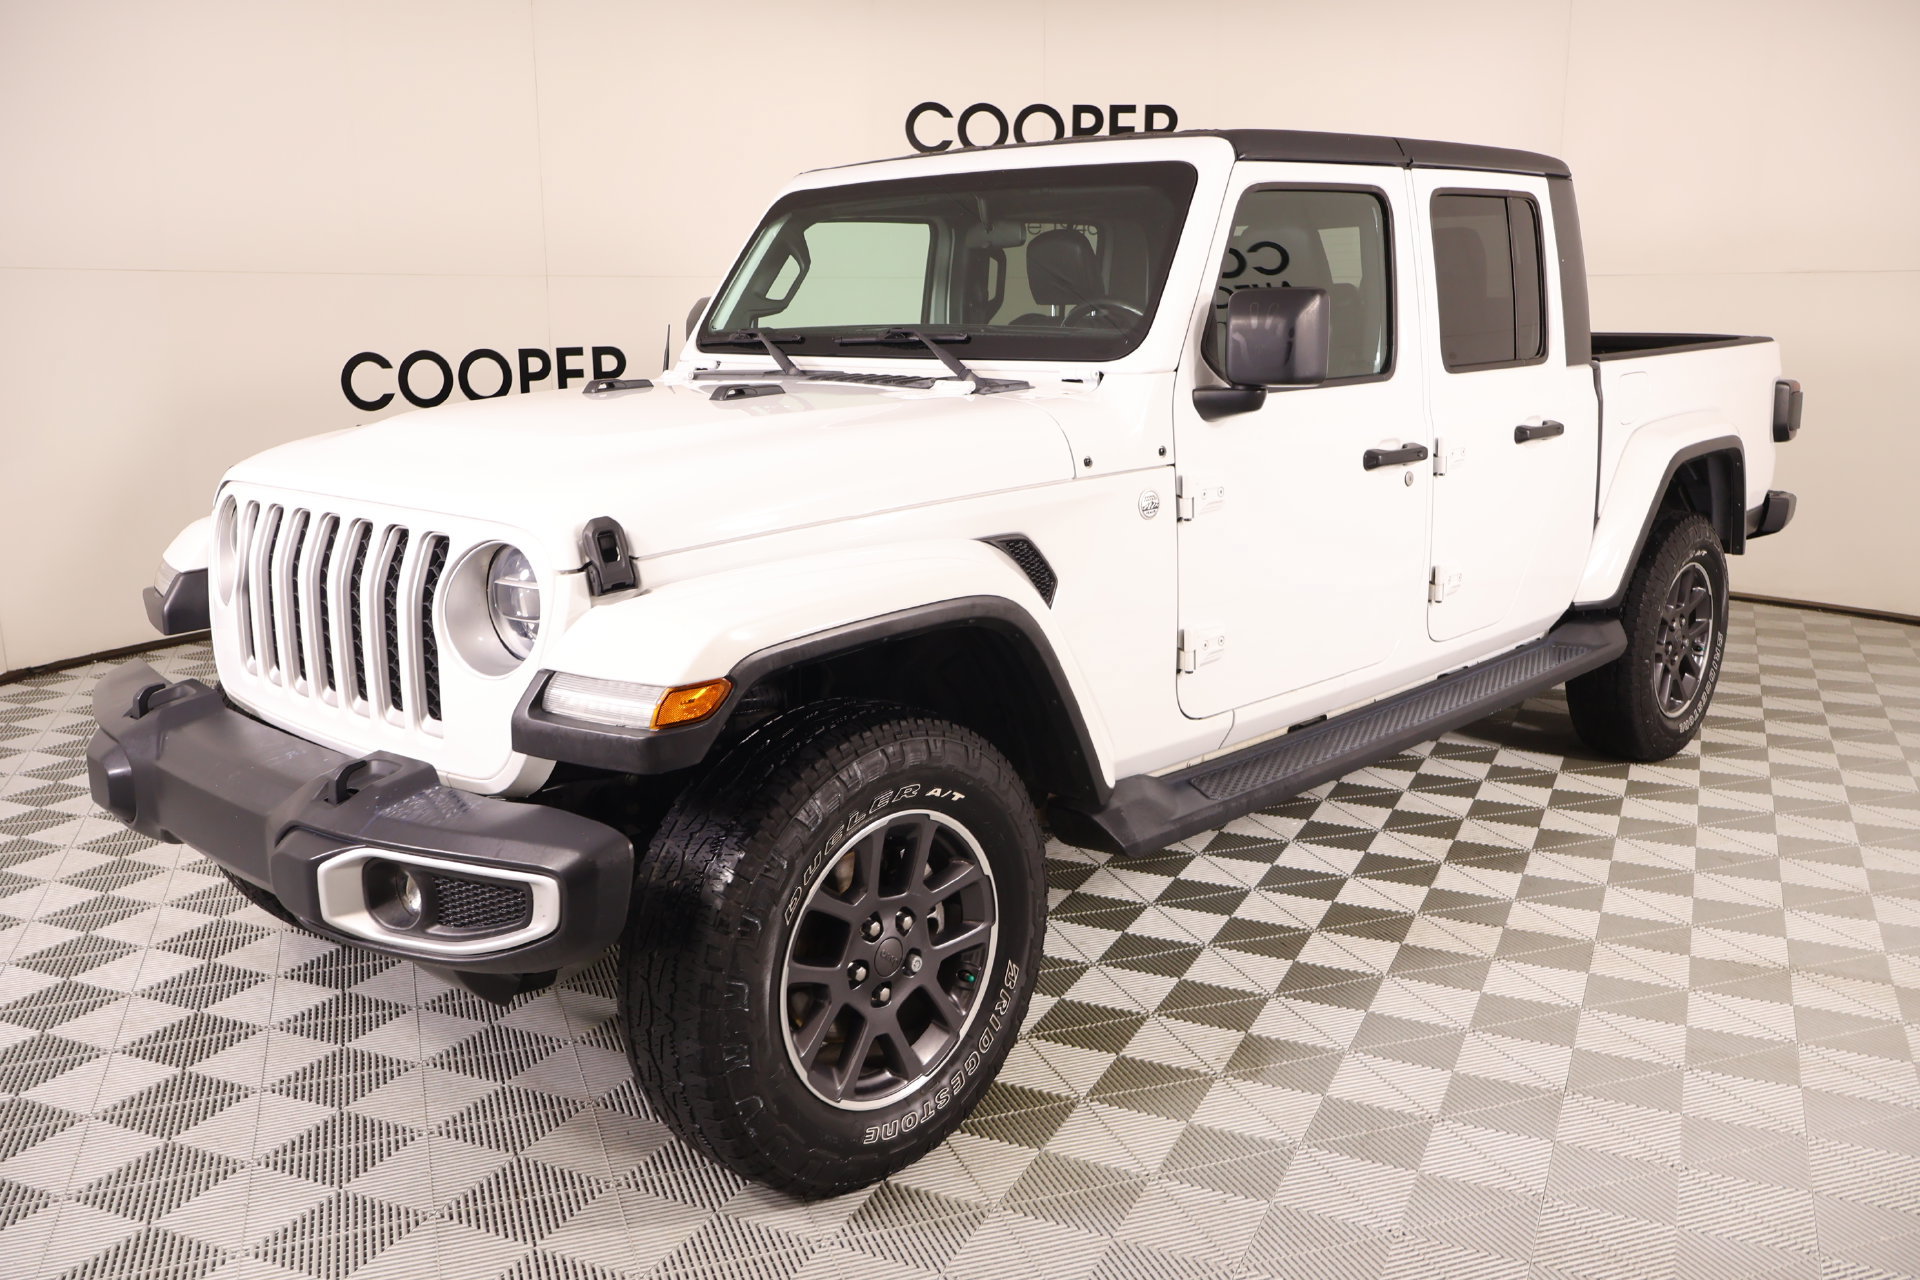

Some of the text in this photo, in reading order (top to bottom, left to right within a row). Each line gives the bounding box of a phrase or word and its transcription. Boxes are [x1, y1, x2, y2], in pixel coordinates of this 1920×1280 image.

[341, 346, 627, 411] COOPER
[784, 783, 966, 926] DUELER A/T
[863, 959, 1020, 1145] BRIDGESTONE
